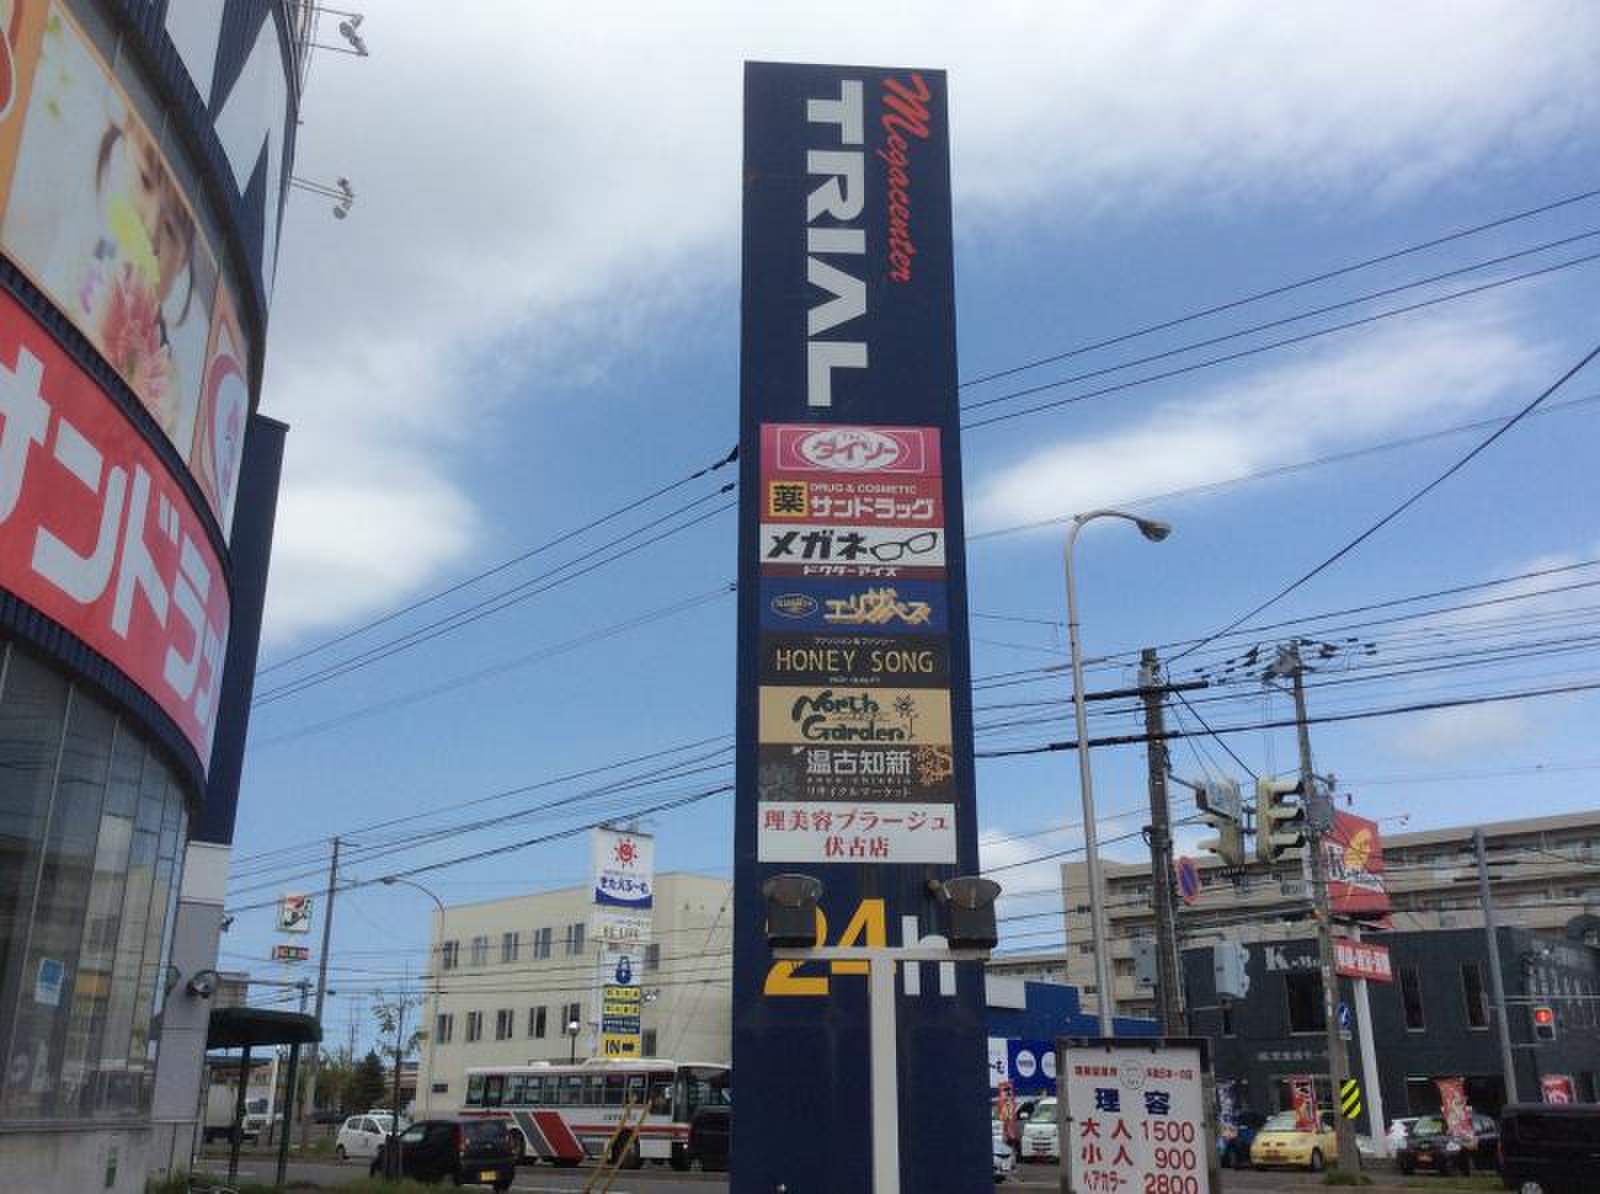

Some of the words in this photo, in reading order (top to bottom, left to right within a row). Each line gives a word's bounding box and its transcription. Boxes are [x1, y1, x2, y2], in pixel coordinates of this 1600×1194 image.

[876, 72, 931, 283] Megacenter
[807, 79, 868, 407] TRIAL
[812, 437, 897, 461] ダイソー
[773, 484, 804, 513] 薬
[857, 484, 917, 494] COSMETIC
[811, 496, 934, 520] サンドラッグ
[767, 530, 868, 561] メガネ
[776, 649, 855, 672] HONEY
[871, 651, 933, 673] SONG
[792, 690, 880, 722] North
[801, 714, 906, 742] Garden
[806, 750, 912, 776] 温古知新
[764, 809, 950, 833] 理美容プラージュ
[825, 836, 889, 858] 伏古店
[605, 1040, 620, 1054] IN
[1095, 1087, 1171, 1116] 理容
[1080, 1117, 1132, 1139] 大人
[1140, 1120, 1195, 1143] 1500
[1081, 1142, 1133, 1166] 小人
[1154, 1147, 1196, 1170] 900
[1144, 1172, 1199, 1194] 2800
